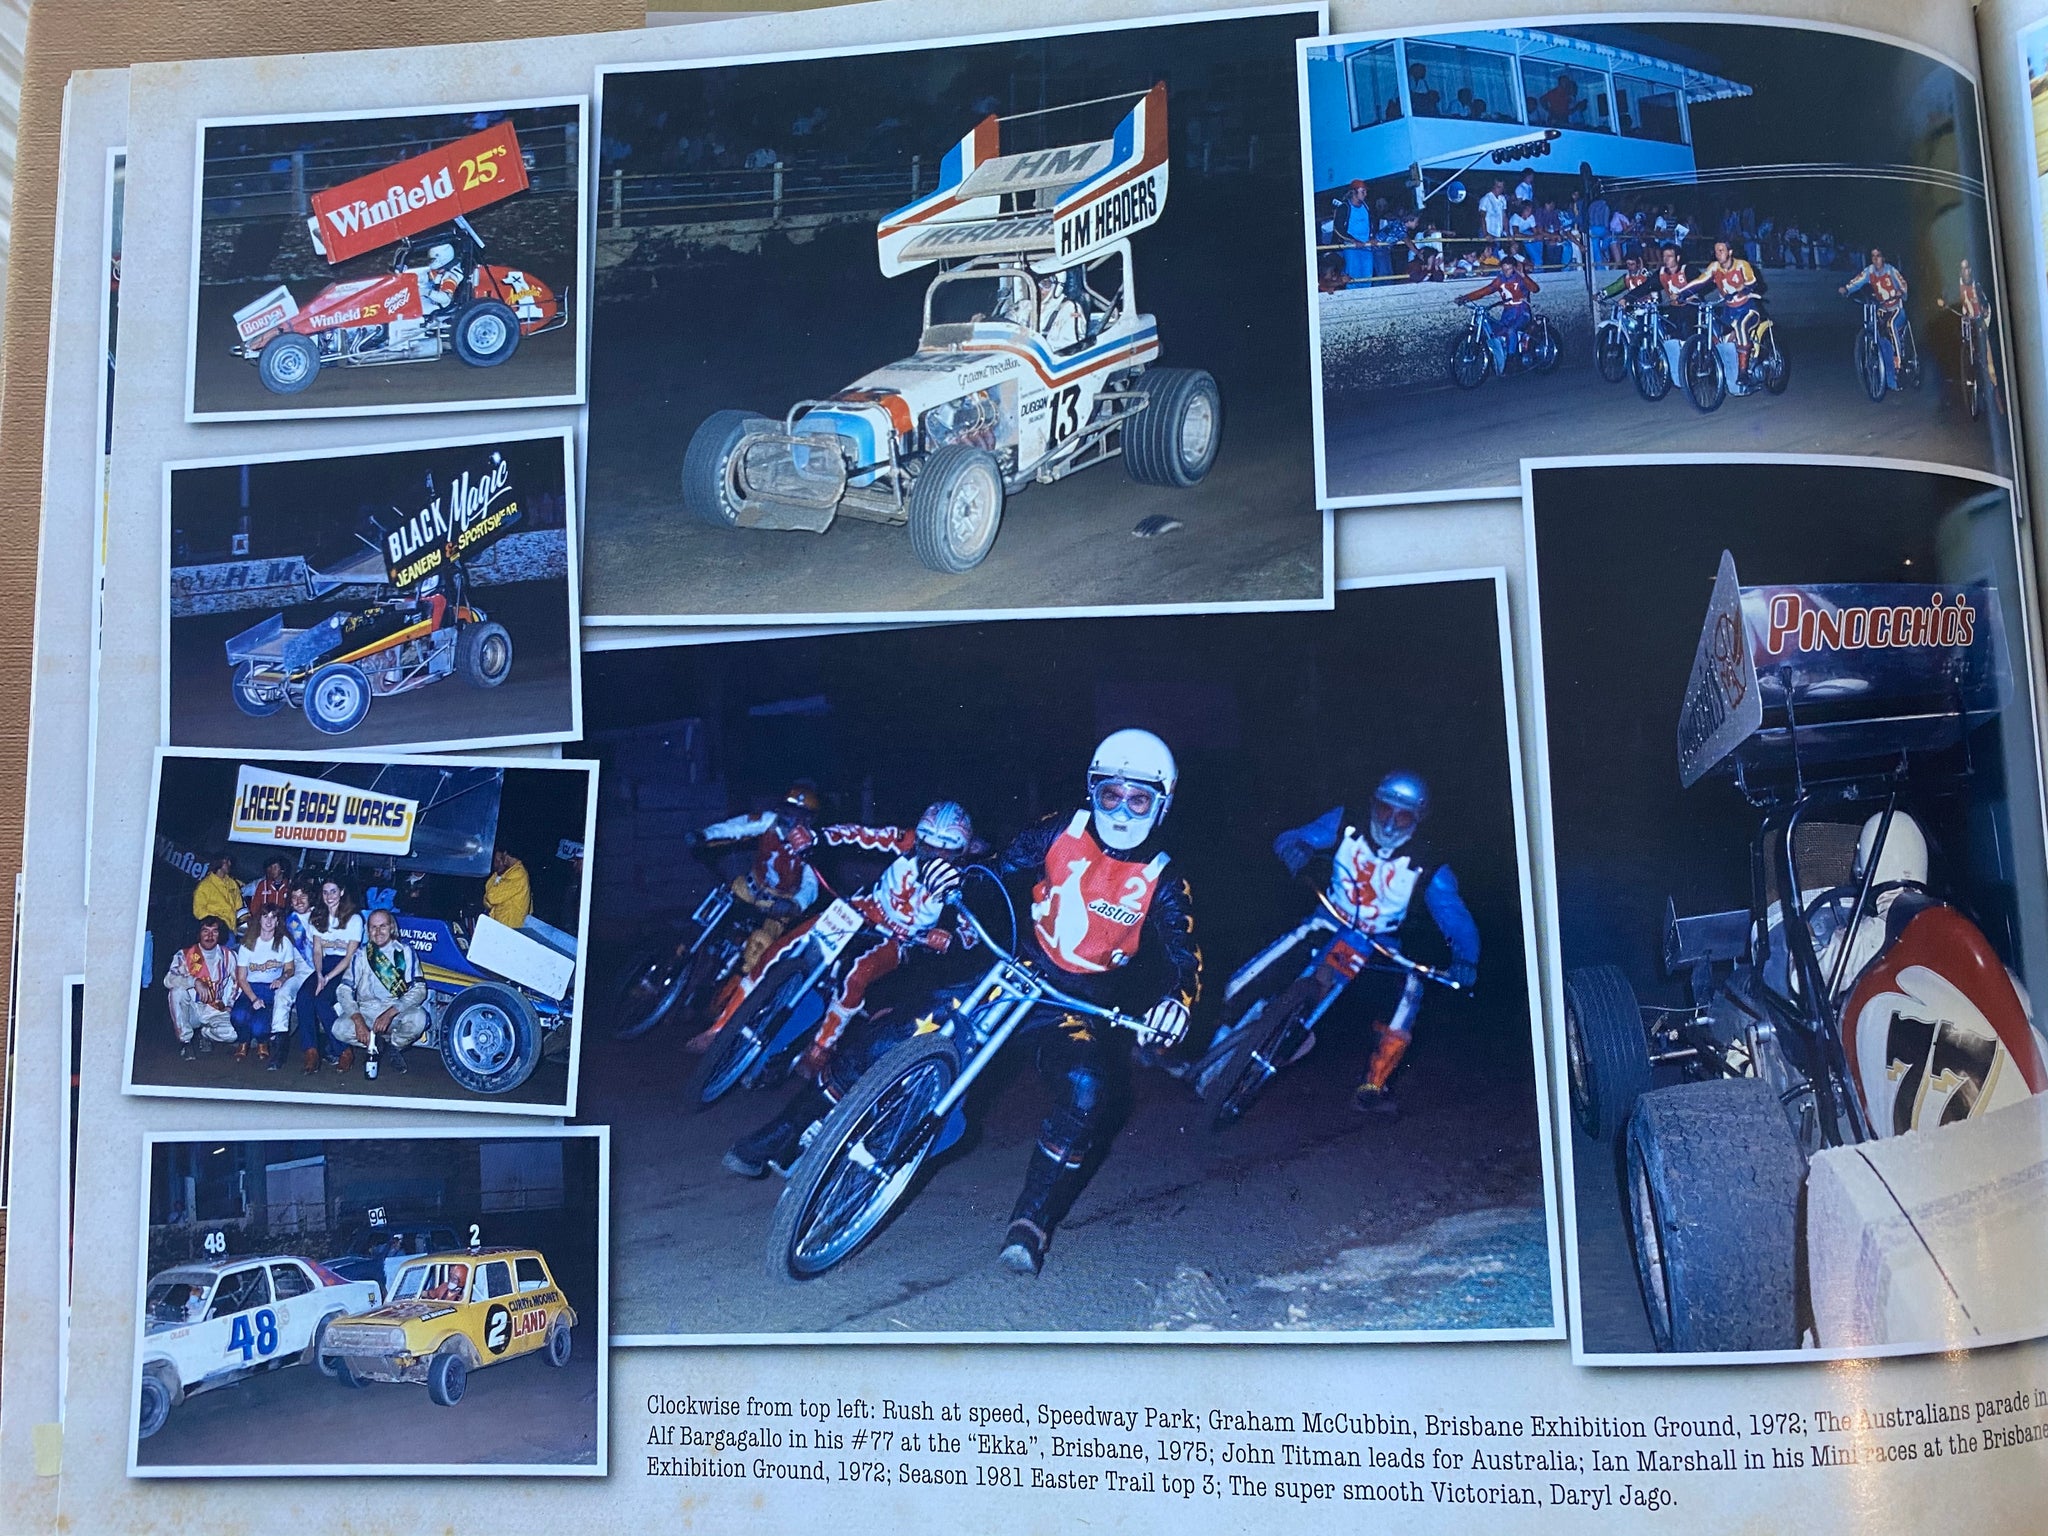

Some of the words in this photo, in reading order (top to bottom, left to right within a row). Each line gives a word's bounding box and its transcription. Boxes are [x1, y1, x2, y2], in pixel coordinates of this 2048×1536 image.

[1003, 145, 1101, 182] HM
[325, 166, 455, 238] Winfield
[457, 144, 507, 191] 25's
[1095, 175, 1158, 242] HEADERS
[1513, 282, 1519, 291] 7
[1732, 273, 1739, 283] 4
[310, 307, 361, 329] Winfield
[1049, 384, 1082, 443] 13
[388, 497, 447, 564] BLACK
[447, 460, 512, 542] Magic
[396, 549, 442, 587] JEANERY
[458, 502, 518, 550] SPORTSWEAR
[240, 781, 296, 822] LACEY'S
[297, 790, 341, 824] BODY
[343, 796, 408, 828] WORKS
[274, 825, 348, 843] BURWOOD
[156, 834, 210, 880] Winfiel
[1120, 876, 1147, 910] 2
[400, 928, 412, 938] VAL
[412, 929, 438, 941] TRACK
[1886, 1010, 2000, 1136] 77
[369, 1209, 386, 1225] 94
[469, 1224, 480, 1246] 2
[204, 1231, 226, 1253] 48
[227, 1309, 280, 1361] 48
[488, 1311, 508, 1348] 2
[513, 1309, 547, 1338] LAND
[647, 1395, 740, 1415] Clockwise
[747, 1396, 793, 1416] from
[800, 1399, 830, 1423] top
[837, 1399, 874, 1420] left:
[883, 1400, 934, 1420] Rush
[941, 1403, 961, 1421] at
[969, 1403, 1029, 1427] speed,
[1038, 1404, 1139, 1432] Speedway
[1145, 1407, 1200, 1433] Park;
[1209, 1410, 1295, 1432] Graham
[1302, 1412, 1417, 1439] McCubbin,
[1425, 1415, 1523, 1436] Brisbane
[1531, 1416, 1647, 1437] Exhibition
[1654, 1415, 1740, 1439] Ground,
[1750, 1413, 1807, 1437] 1972;
[1815, 1410, 1851, 1433] The
[1859, 1403, 1970, 1431] Australians
[1975, 1391, 2029, 1423] parade
[2034, 1388, 2048, 1408] in
[647, 1425, 675, 1449] Alf
[680, 1426, 782, 1455] Bargagallo
[789, 1429, 808, 1448] in
[814, 1429, 843, 1449] his
[851, 1429, 893, 1452] #77
[901, 1433, 921, 1451] at
[928, 1433, 960, 1453] the
[1052, 1436, 1148, 1464] Brisbane,
[1158, 1440, 1214, 1466] 1975;
[1222, 1442, 1275, 1464] John
[1282, 1444, 1362, 1467] Titman
[1368, 1447, 1425, 1468] leads
[1432, 1448, 1463, 1469] for
[1471, 1449, 1584, 1475] Australia;
[1593, 1450, 1630, 1471] Ian
[1637, 1449, 1737, 1471] Marshall
[1744, 1449, 1766, 1469] in
[1773, 1448, 1804, 1468] his
[1811, 1445, 1857, 1467] Mini
[1865, 1443, 1917, 1463] races
[1924, 1437, 1943, 1458] at
[1949, 1434, 1978, 1456] the
[1982, 1422, 2048, 1450] Brisbane
[647, 1454, 747, 1478] Exhibition
[753, 1456, 829, 1484] Ground,
[838, 1459, 891, 1486] 1972;
[899, 1463, 968, 1485] Season
[976, 1464, 1024, 1487] 1981
[1031, 1468, 1098, 1490] Easter
[1105, 1470, 1155, 1492] Trail
[1162, 1474, 1195, 1499] top
[1203, 1474, 1221, 1499] 3;
[1229, 1475, 1267, 1496] The
[1275, 1482, 1335, 1503] super
[1344, 1481, 1425, 1502] smooth
[1433, 1482, 1542, 1508] Victorian,
[1550, 1484, 1612, 1510] Daryl
[1620, 1484, 1677, 1511] Jago.
